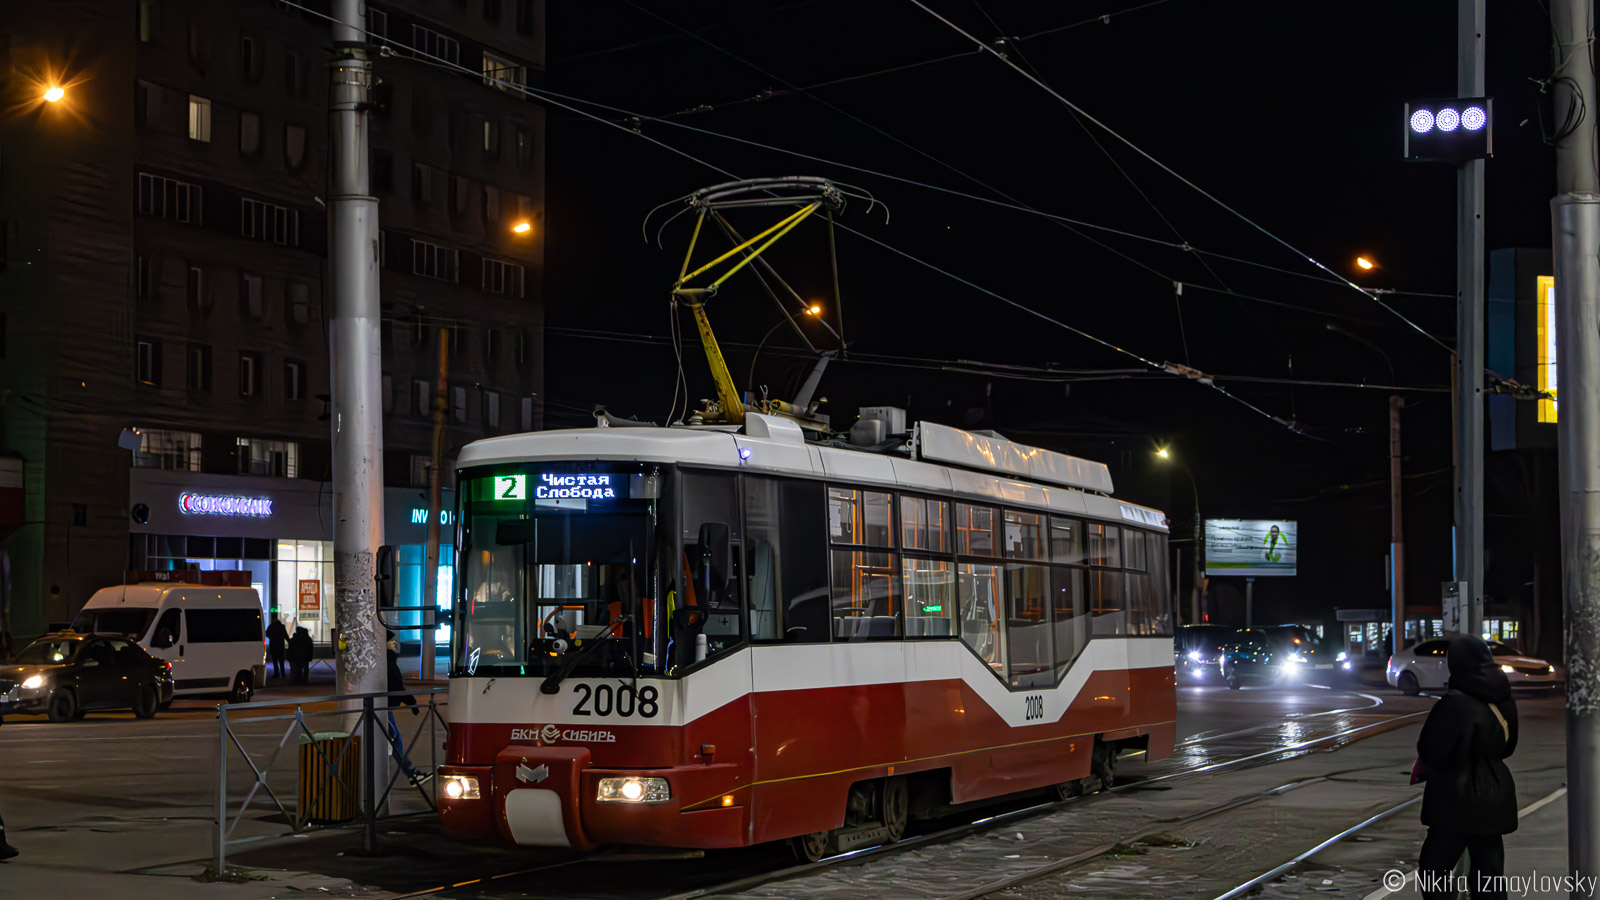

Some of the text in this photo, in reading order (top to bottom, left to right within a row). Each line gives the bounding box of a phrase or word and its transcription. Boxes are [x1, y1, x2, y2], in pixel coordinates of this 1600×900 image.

[501, 476, 518, 499] 2
[542, 473, 610, 486] Чистая
[536, 486, 615, 499] Слобода
[191, 494, 273, 515] СОВКОМБАНК
[572, 683, 659, 718] 2008
[1025, 694, 1044, 720] 2008
[510, 728, 616, 742] БКМ СИБИРЬ
